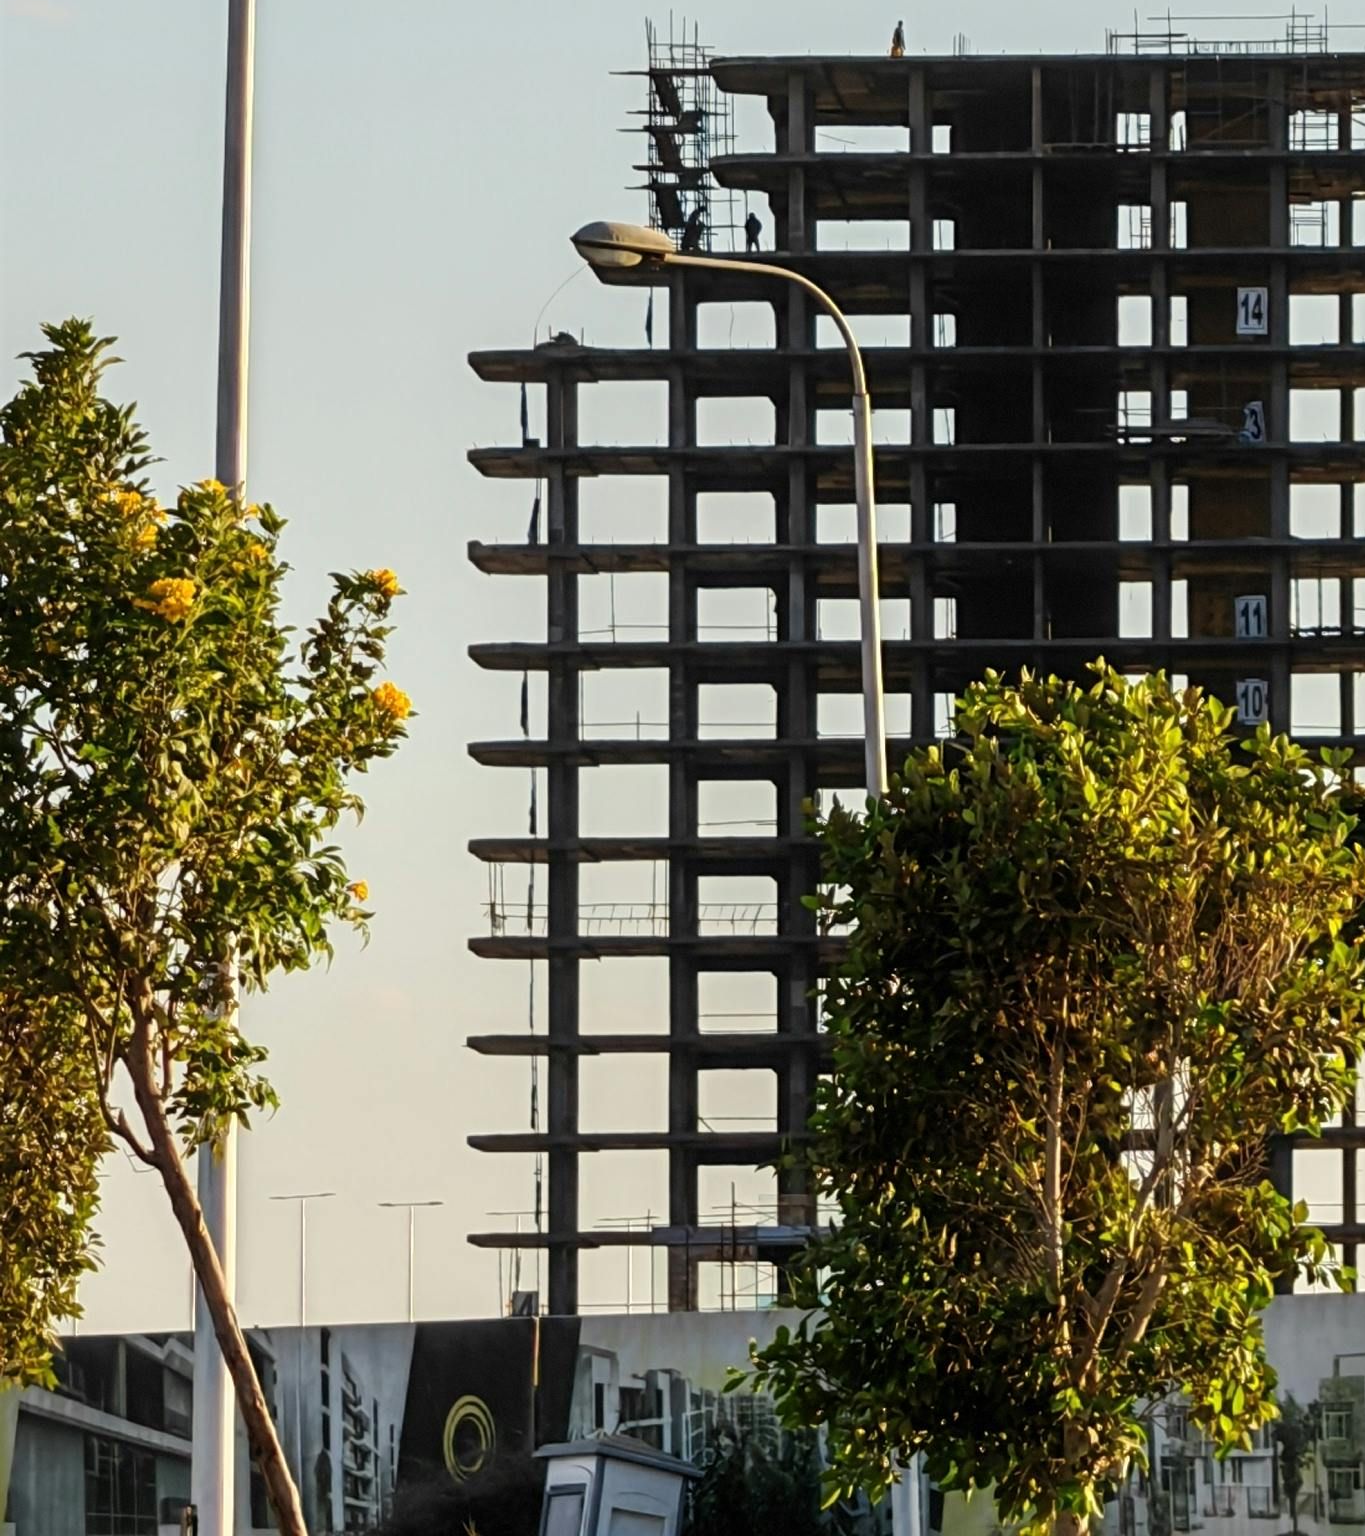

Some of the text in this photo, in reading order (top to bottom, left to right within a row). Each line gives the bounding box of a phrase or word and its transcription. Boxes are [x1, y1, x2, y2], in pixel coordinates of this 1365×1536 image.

[1240, 293, 1263, 326] 14
[1240, 601, 1262, 636] 11
[1241, 684, 1263, 717] 10
